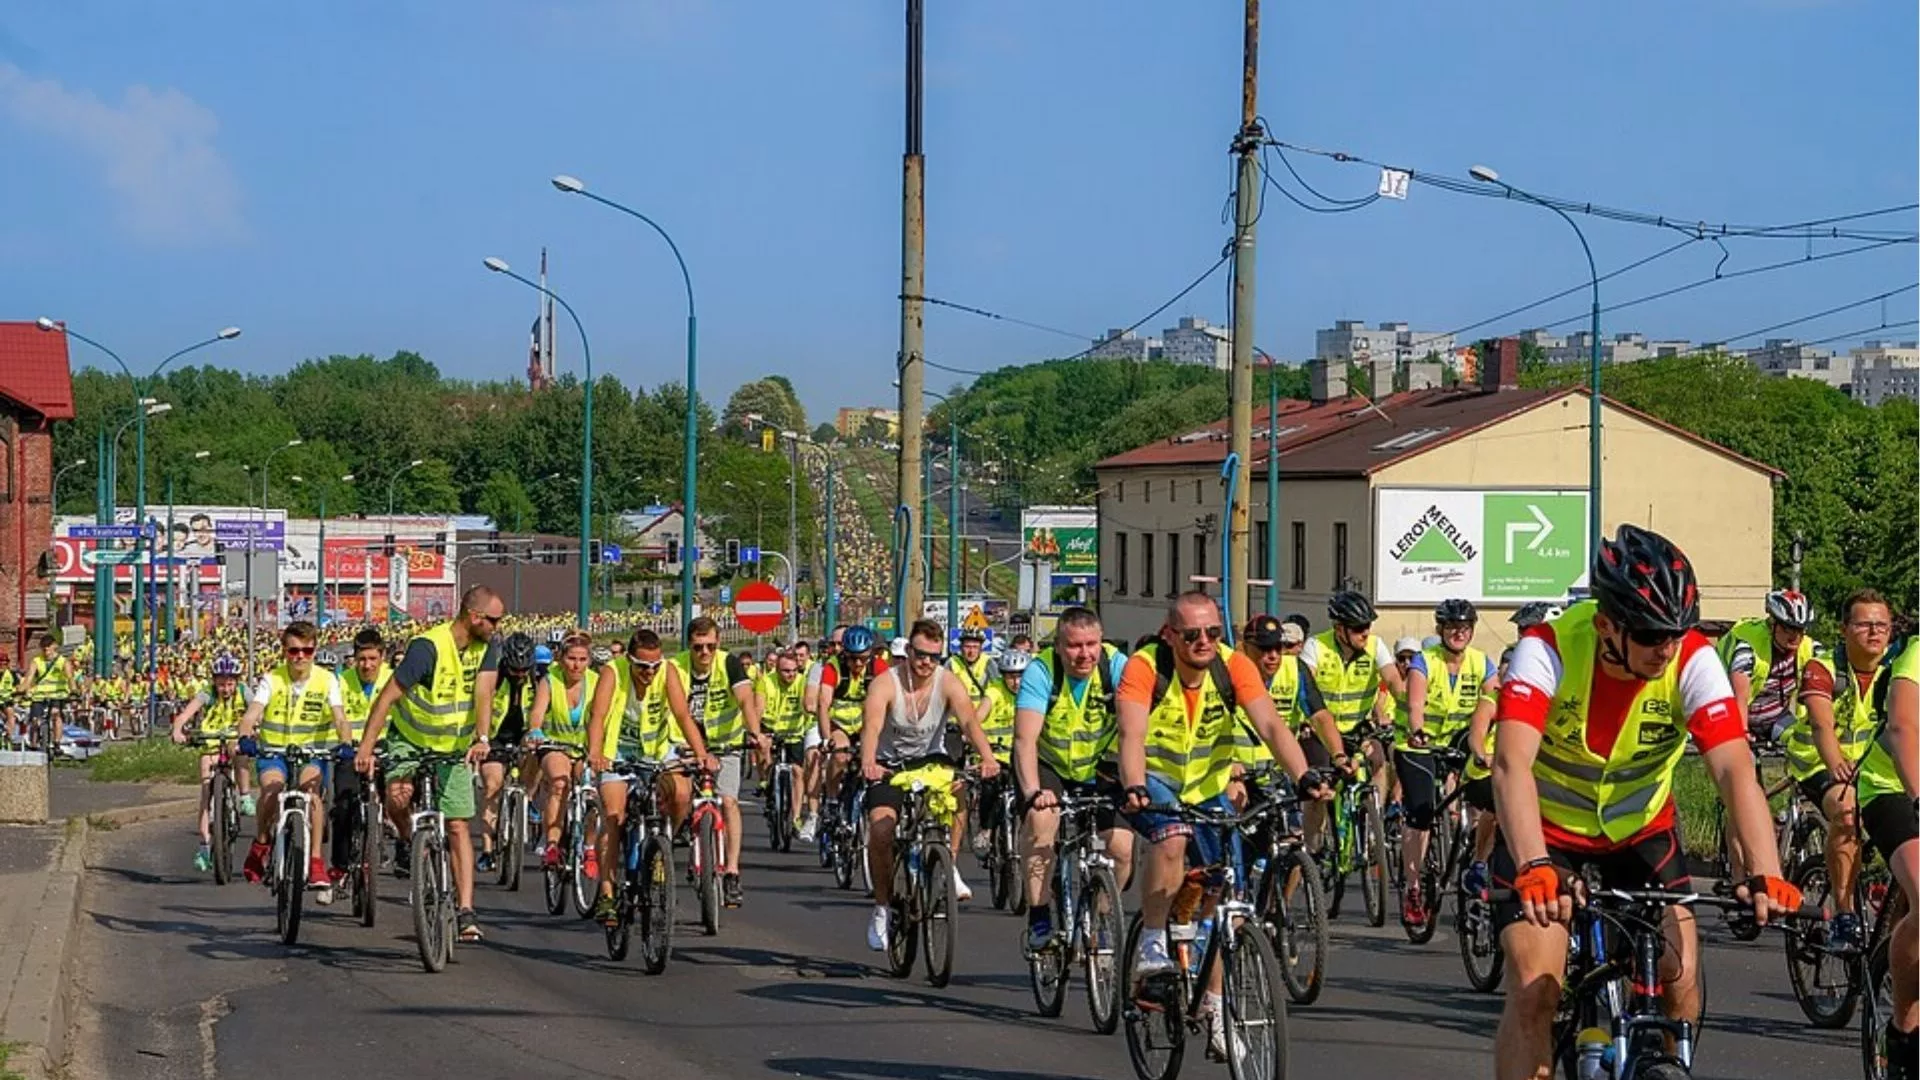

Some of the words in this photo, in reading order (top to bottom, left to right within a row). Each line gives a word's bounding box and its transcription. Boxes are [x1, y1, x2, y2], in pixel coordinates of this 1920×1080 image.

[1389, 514, 1430, 560] LEROY
[1427, 505, 1477, 561] MERLIN
[1537, 547, 1553, 558] 4,4
[1555, 547, 1570, 557] km
